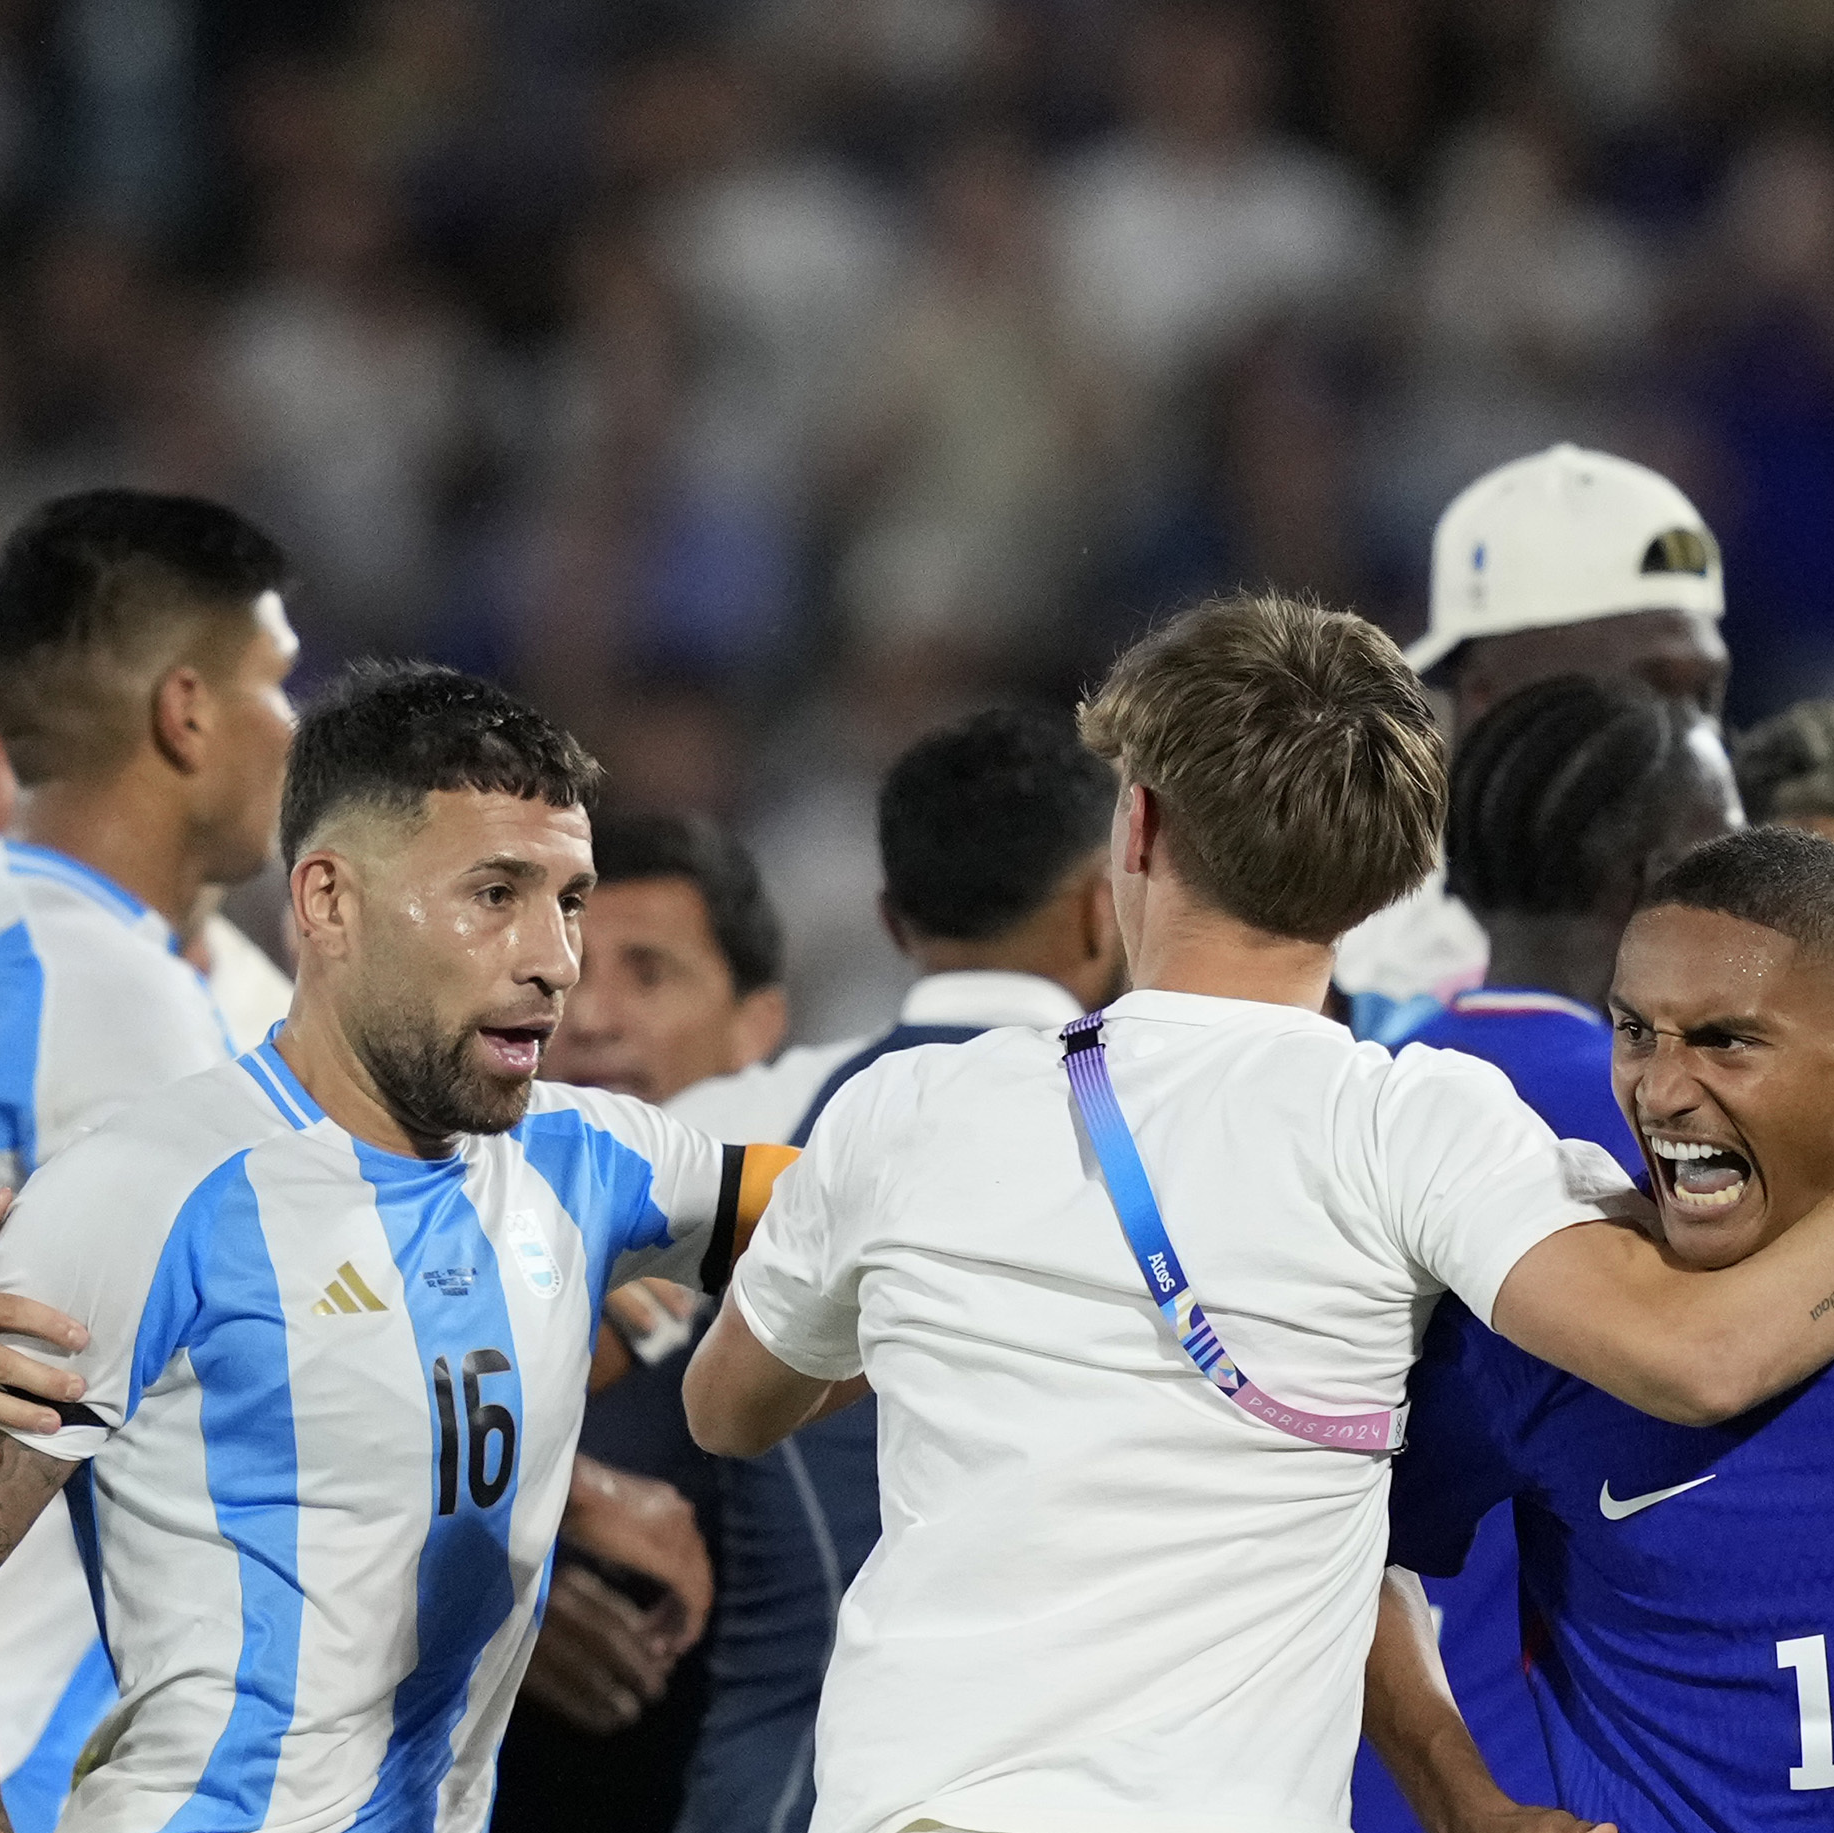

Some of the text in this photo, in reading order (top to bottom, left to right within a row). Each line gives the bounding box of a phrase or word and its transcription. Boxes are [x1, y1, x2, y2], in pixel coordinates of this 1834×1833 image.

[1148, 1252, 1176, 1293] Atos
[433, 1348, 516, 1516] 16
[1248, 1397, 1380, 1440] PARIS 2024
